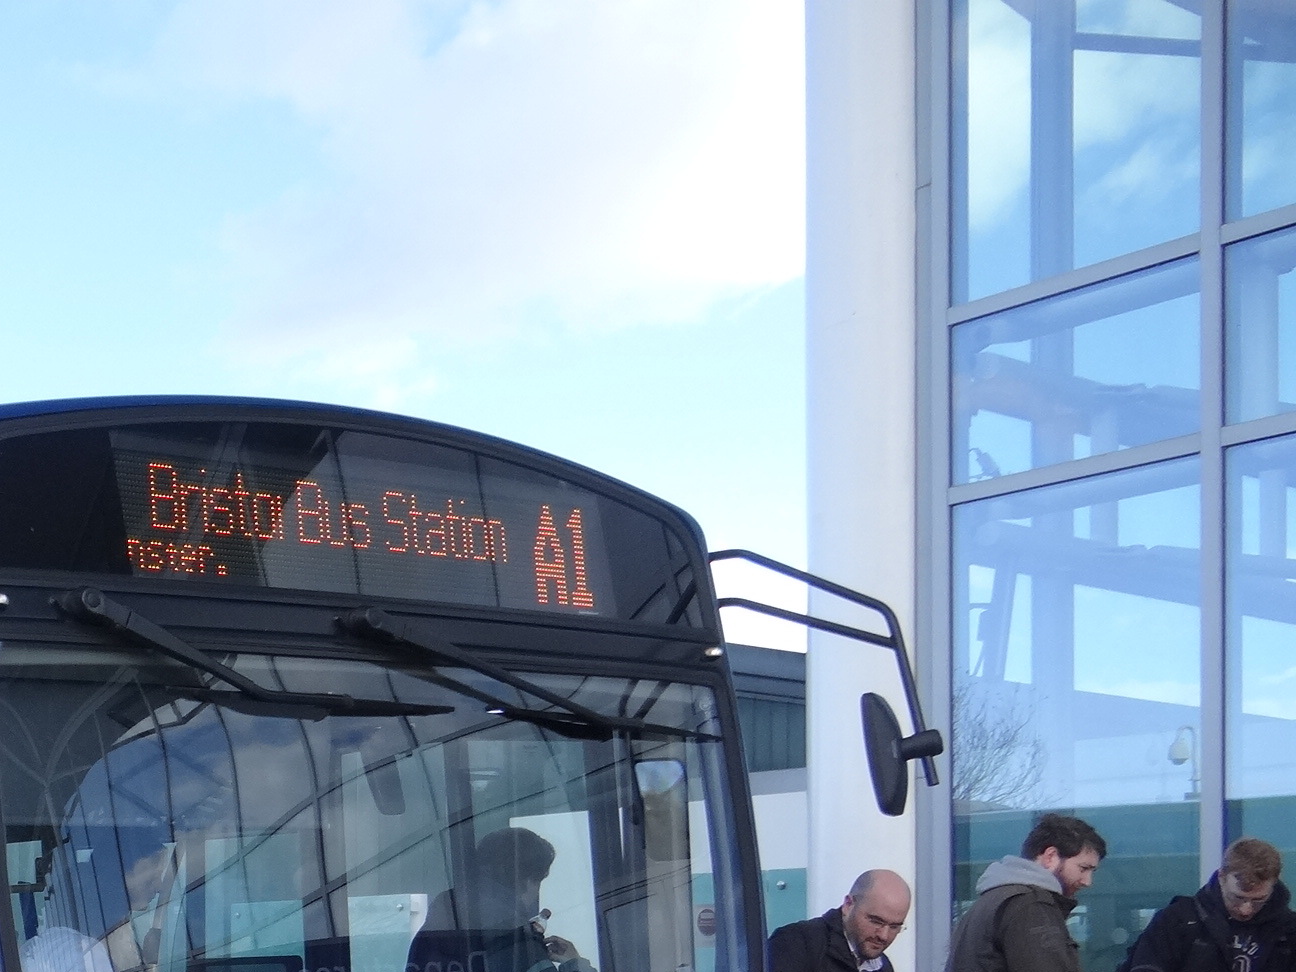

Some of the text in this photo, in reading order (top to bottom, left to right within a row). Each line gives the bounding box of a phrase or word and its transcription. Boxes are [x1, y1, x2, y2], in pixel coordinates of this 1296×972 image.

[149, 462, 508, 563] Bristol Bus Station
[534, 504, 594, 608] A1
